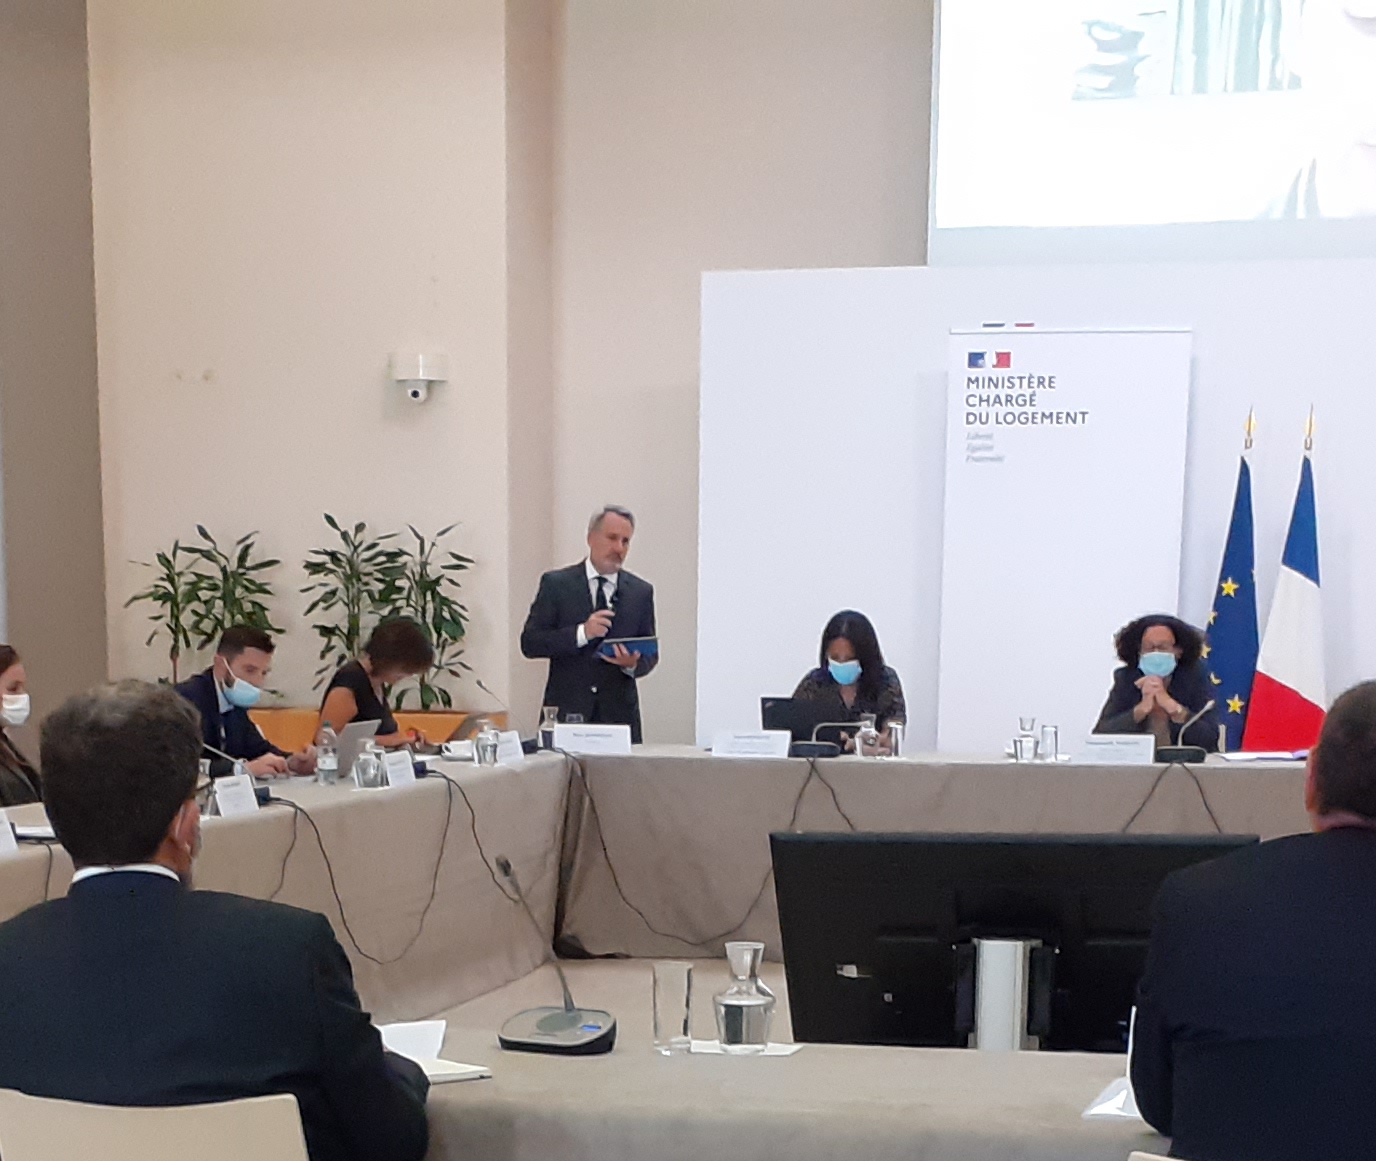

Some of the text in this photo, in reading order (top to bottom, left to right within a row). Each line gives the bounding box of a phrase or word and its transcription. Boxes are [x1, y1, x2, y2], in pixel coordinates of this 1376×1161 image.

[966, 373, 1056, 389] MINISTÈRE
[965, 390, 1037, 407] CHARGÉ
[965, 411, 1089, 425] DU LOGEMENT
